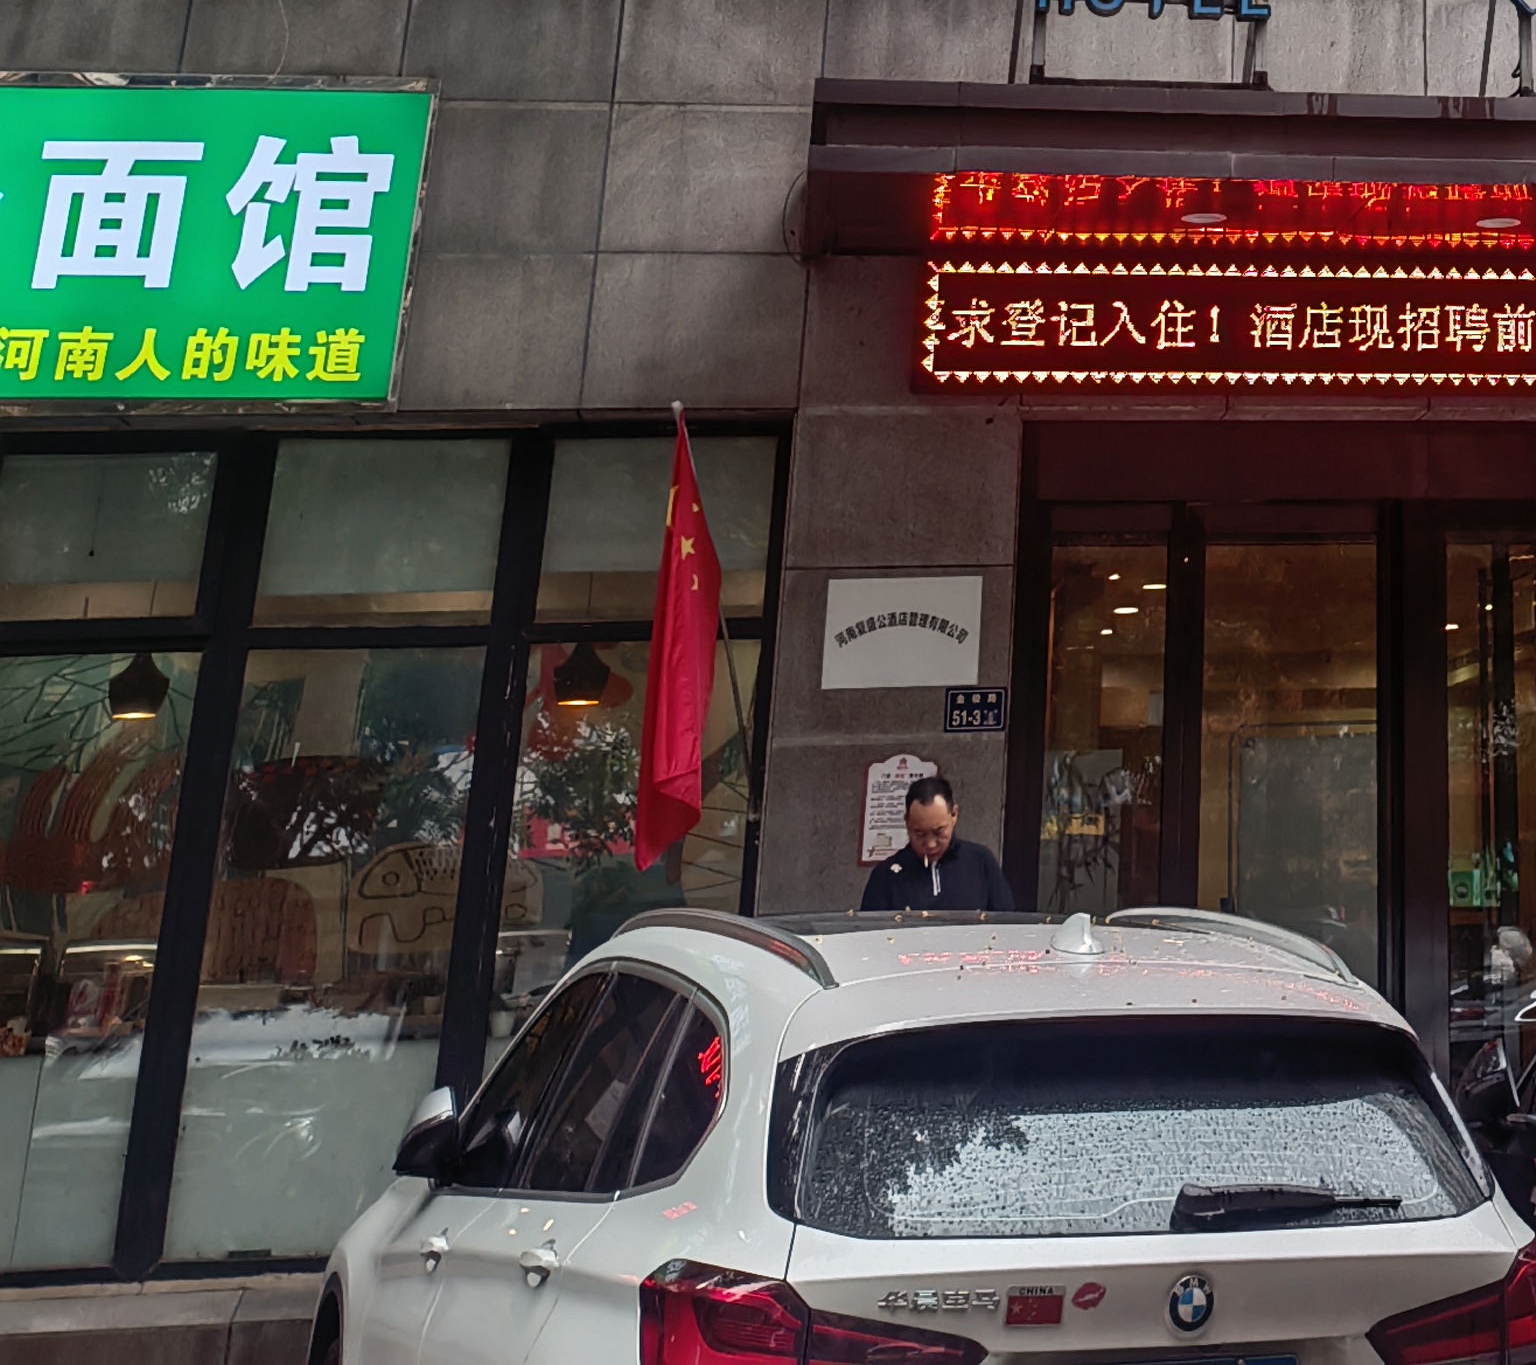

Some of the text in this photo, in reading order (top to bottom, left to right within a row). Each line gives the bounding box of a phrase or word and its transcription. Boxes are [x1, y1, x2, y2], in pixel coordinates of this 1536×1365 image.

[0, 135, 395, 292] 面馆
[0, 325, 366, 383] 河南人的味道
[876, 1287, 1001, 1312] 华晨宝马
[1018, 1286, 1055, 1296] CHINA
